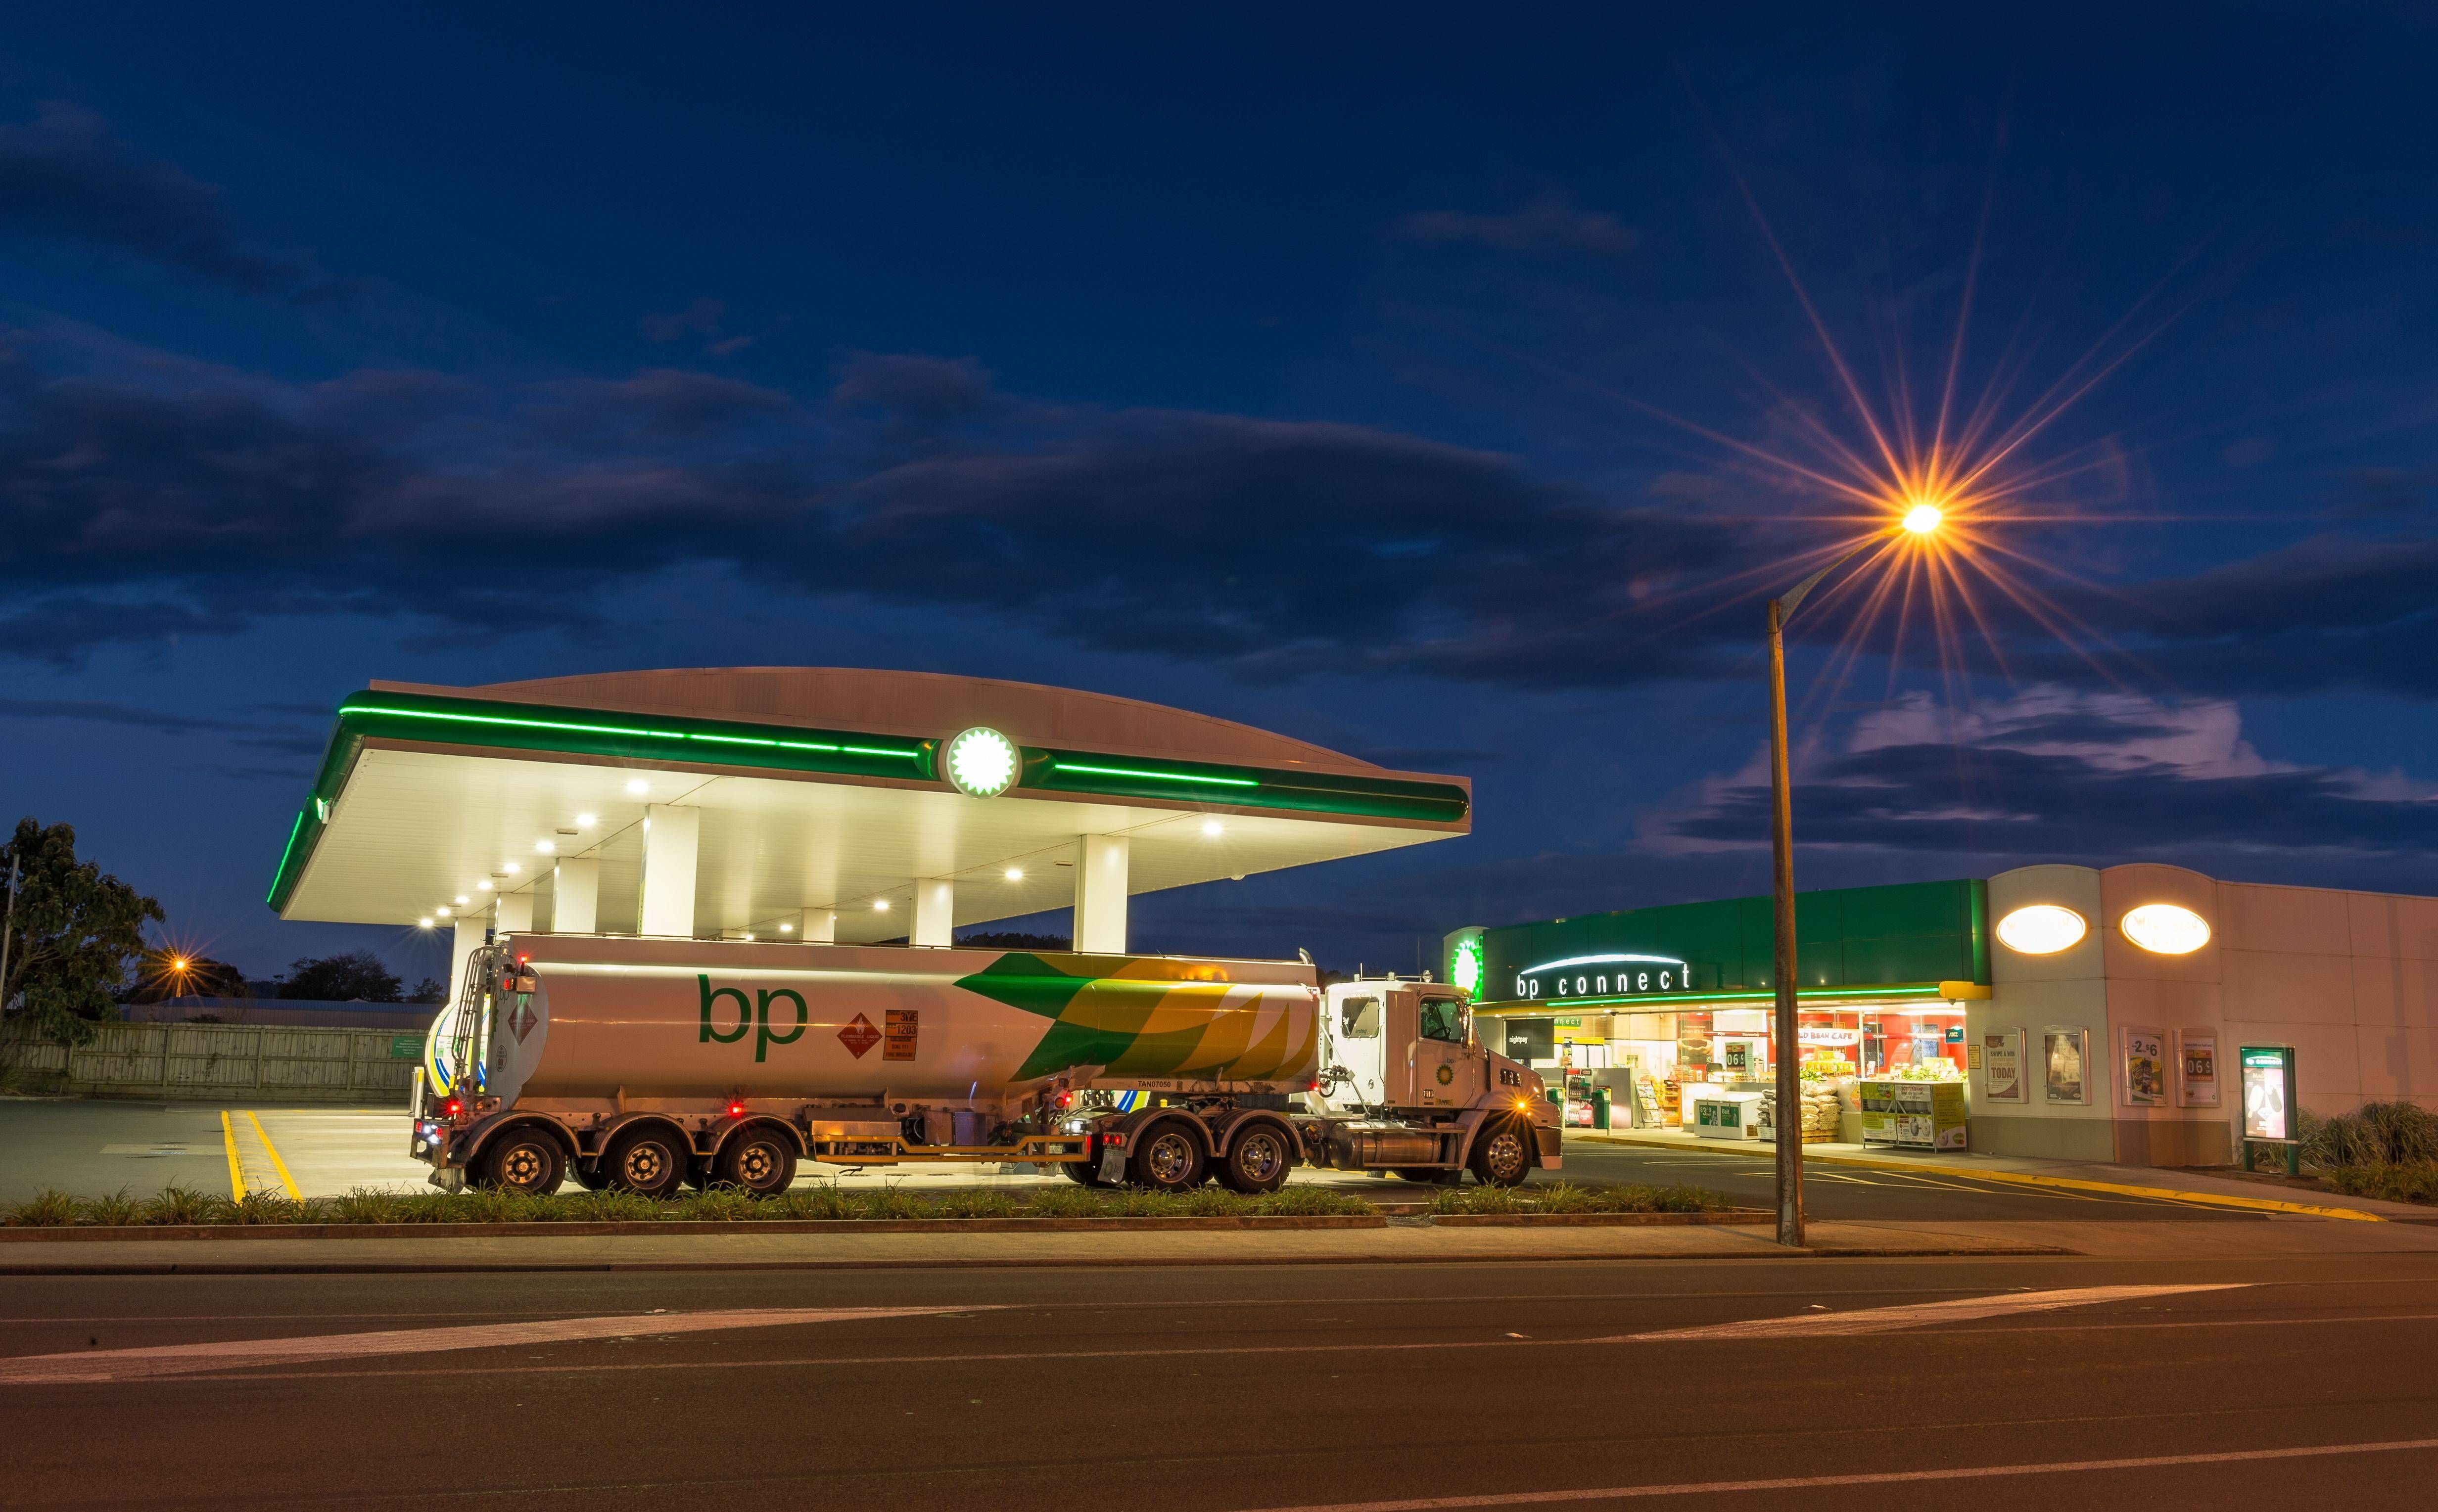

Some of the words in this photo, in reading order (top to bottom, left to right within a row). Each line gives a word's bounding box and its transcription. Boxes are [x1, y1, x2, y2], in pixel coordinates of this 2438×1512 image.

[1517, 974, 1539, 1000] bp
[1559, 963, 1689, 995] connect
[499, 985, 509, 1004] bp
[697, 974, 808, 1062] bp
[900, 1012, 917, 1021] 3YE
[897, 1025, 916, 1035] 1203
[2135, 1040, 2142, 1053] 2
[2146, 1044, 2157, 1056] $6
[1727, 1054, 1738, 1065] 06
[1991, 1067, 2016, 1079] TODAY
